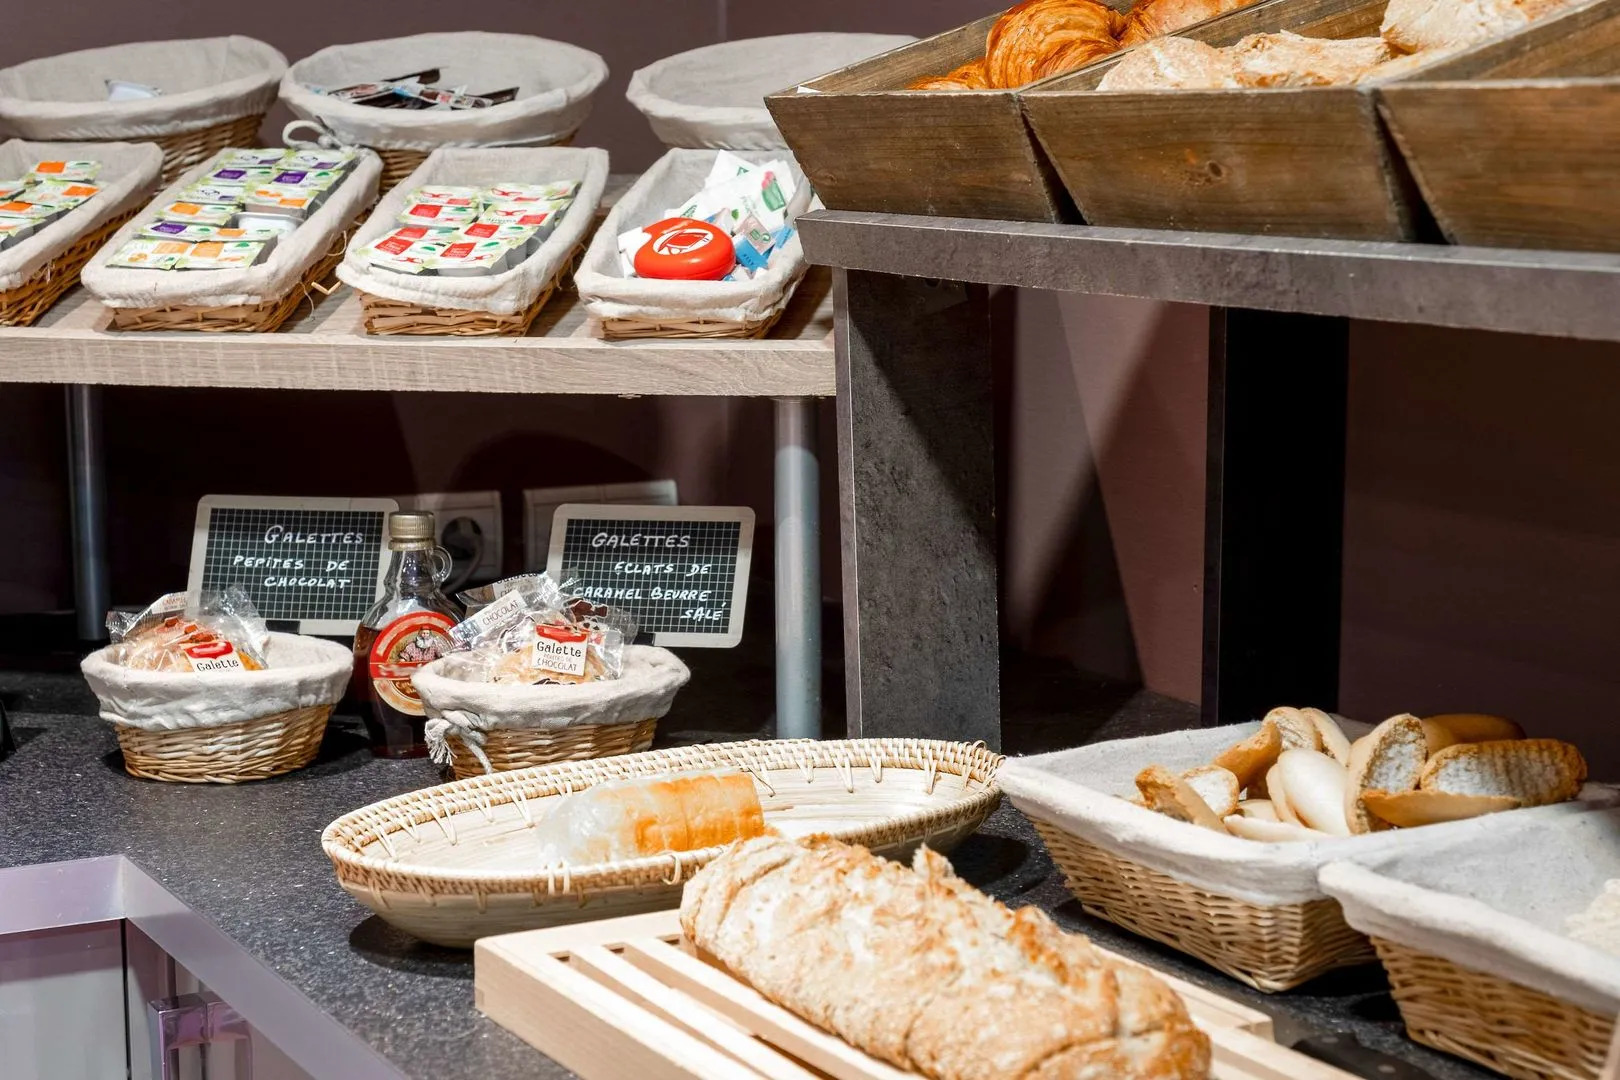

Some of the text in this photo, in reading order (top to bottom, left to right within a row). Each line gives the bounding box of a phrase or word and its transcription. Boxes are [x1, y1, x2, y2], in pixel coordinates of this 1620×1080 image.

[264, 524, 365, 544] GALETTES
[591, 532, 691, 549] GALETTES
[325, 560, 350, 572] DE
[614, 561, 712, 577] ECLATS DE
[263, 576, 351, 589] CHOCOLAT
[572, 586, 712, 602] CARAMEL BEURRE
[481, 599, 520, 626] CHOCOLAT
[680, 602, 727, 622] SALÉ
[536, 640, 582, 658] Galette
[196, 659, 239, 672] Galette
[536, 657, 578, 672] CHOCOLAT
